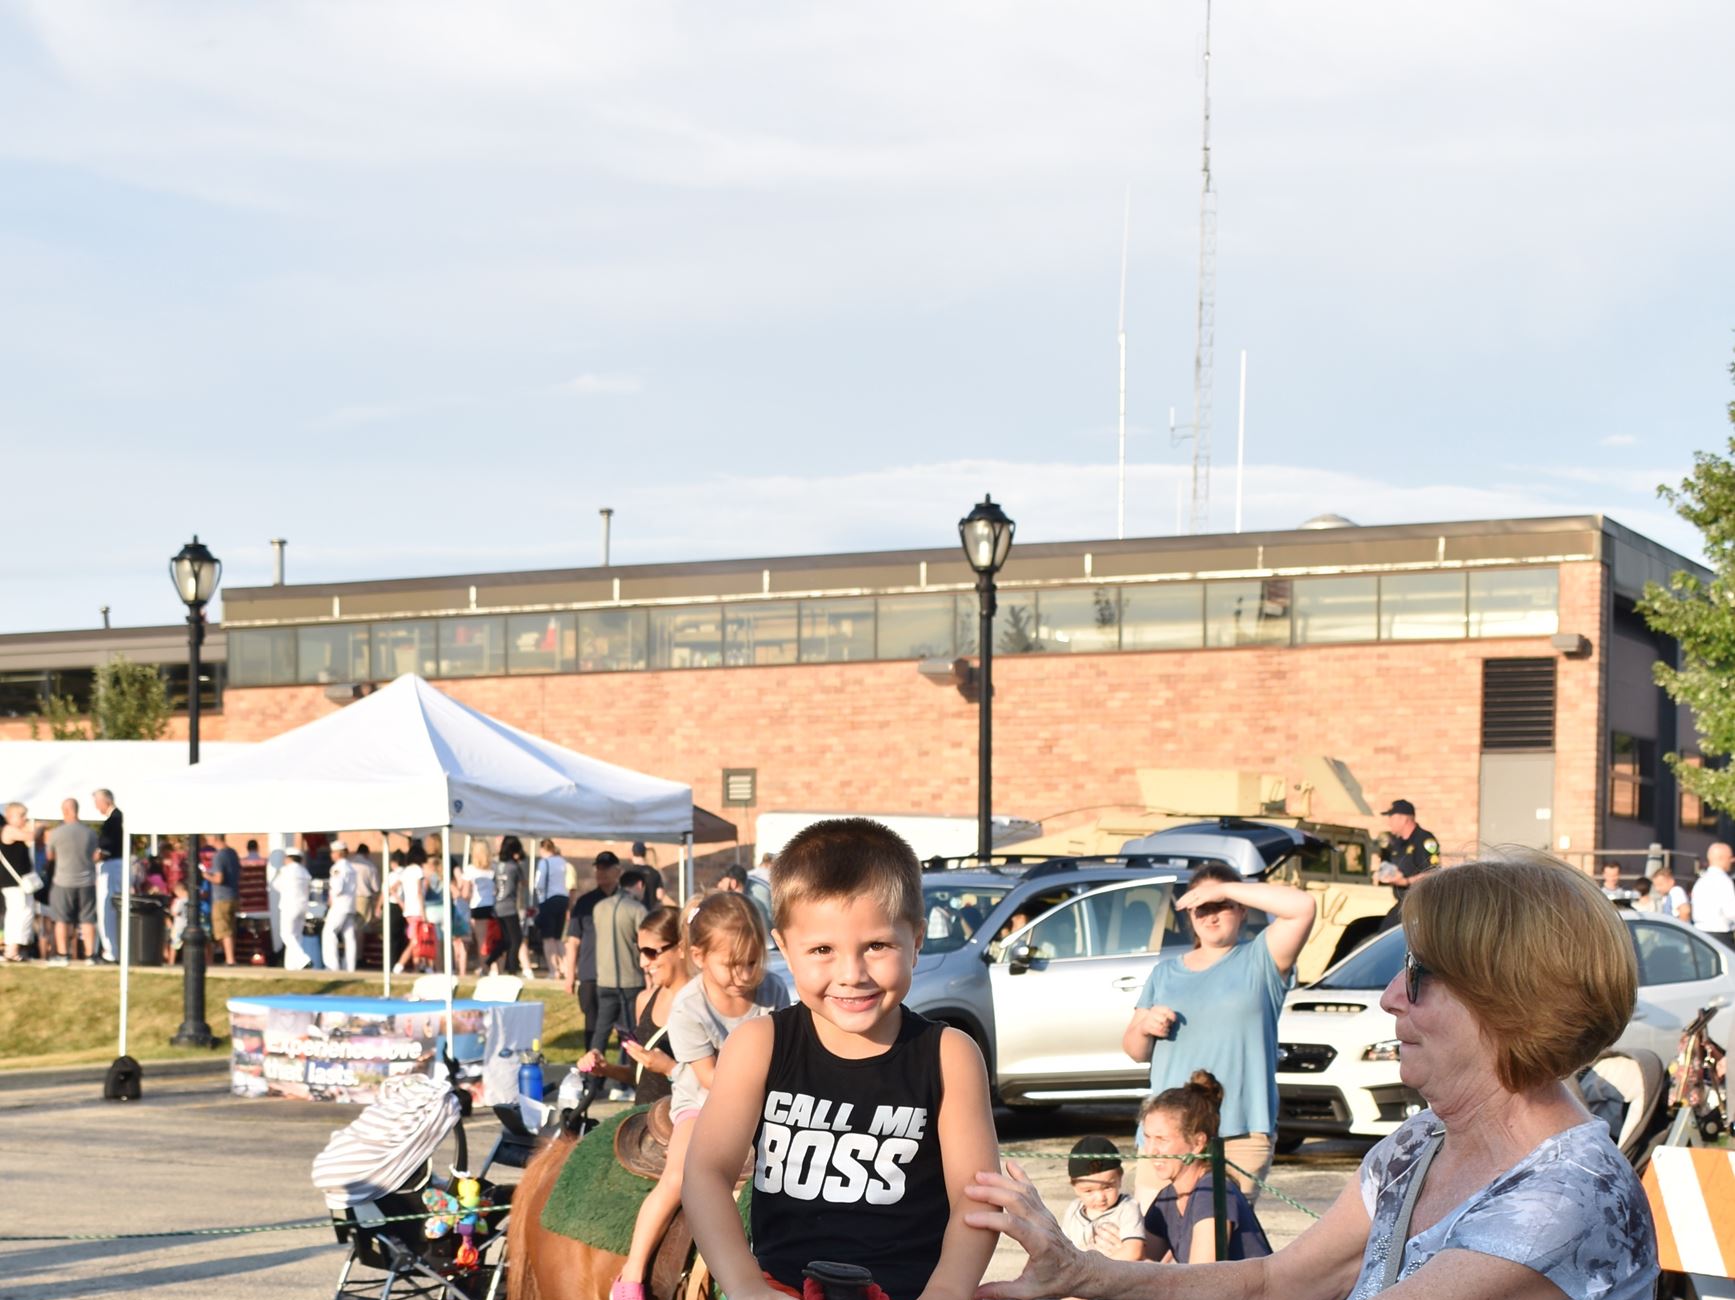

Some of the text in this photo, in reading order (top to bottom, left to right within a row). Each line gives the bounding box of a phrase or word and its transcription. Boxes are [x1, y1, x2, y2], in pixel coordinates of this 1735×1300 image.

[764, 1090, 928, 1140] CALL ME
[754, 1121, 919, 1205] BOSS
